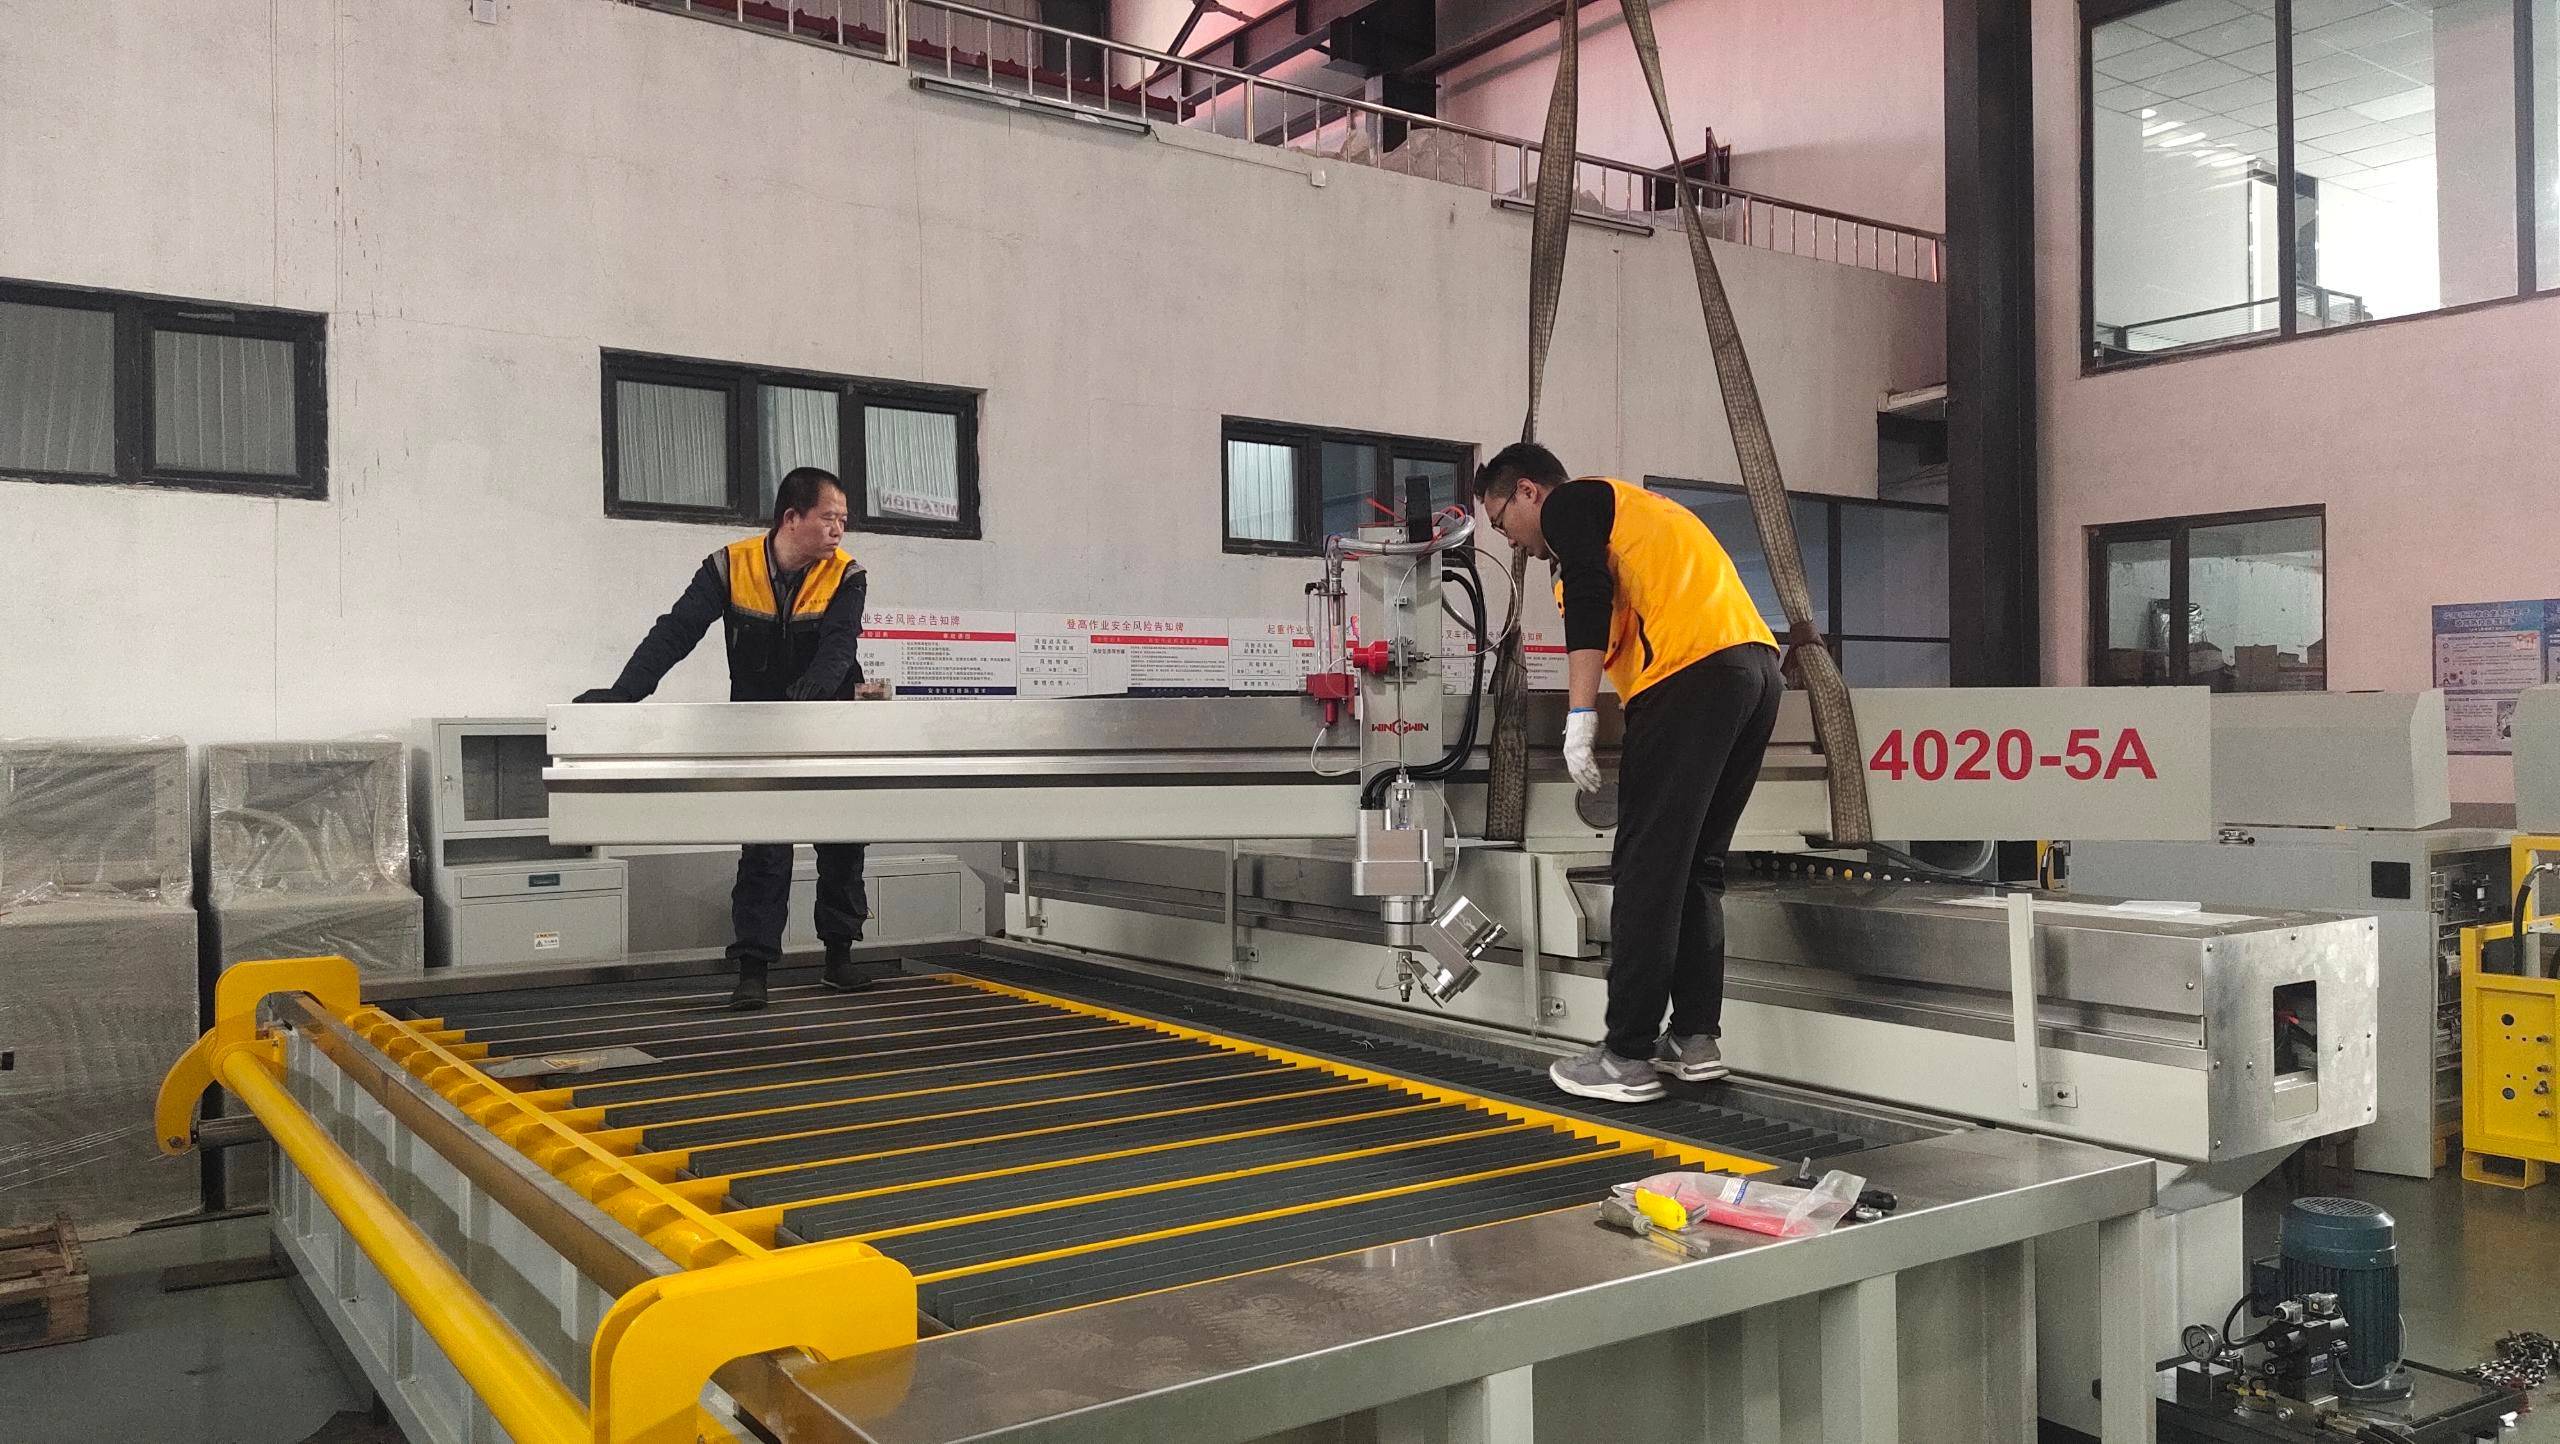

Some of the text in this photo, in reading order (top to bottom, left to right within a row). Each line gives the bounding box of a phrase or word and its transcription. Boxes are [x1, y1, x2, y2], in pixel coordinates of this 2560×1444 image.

[1066, 619, 1184, 632] 登高作业安全风险告知牌
[1869, 727, 2158, 781] 4020-5A
